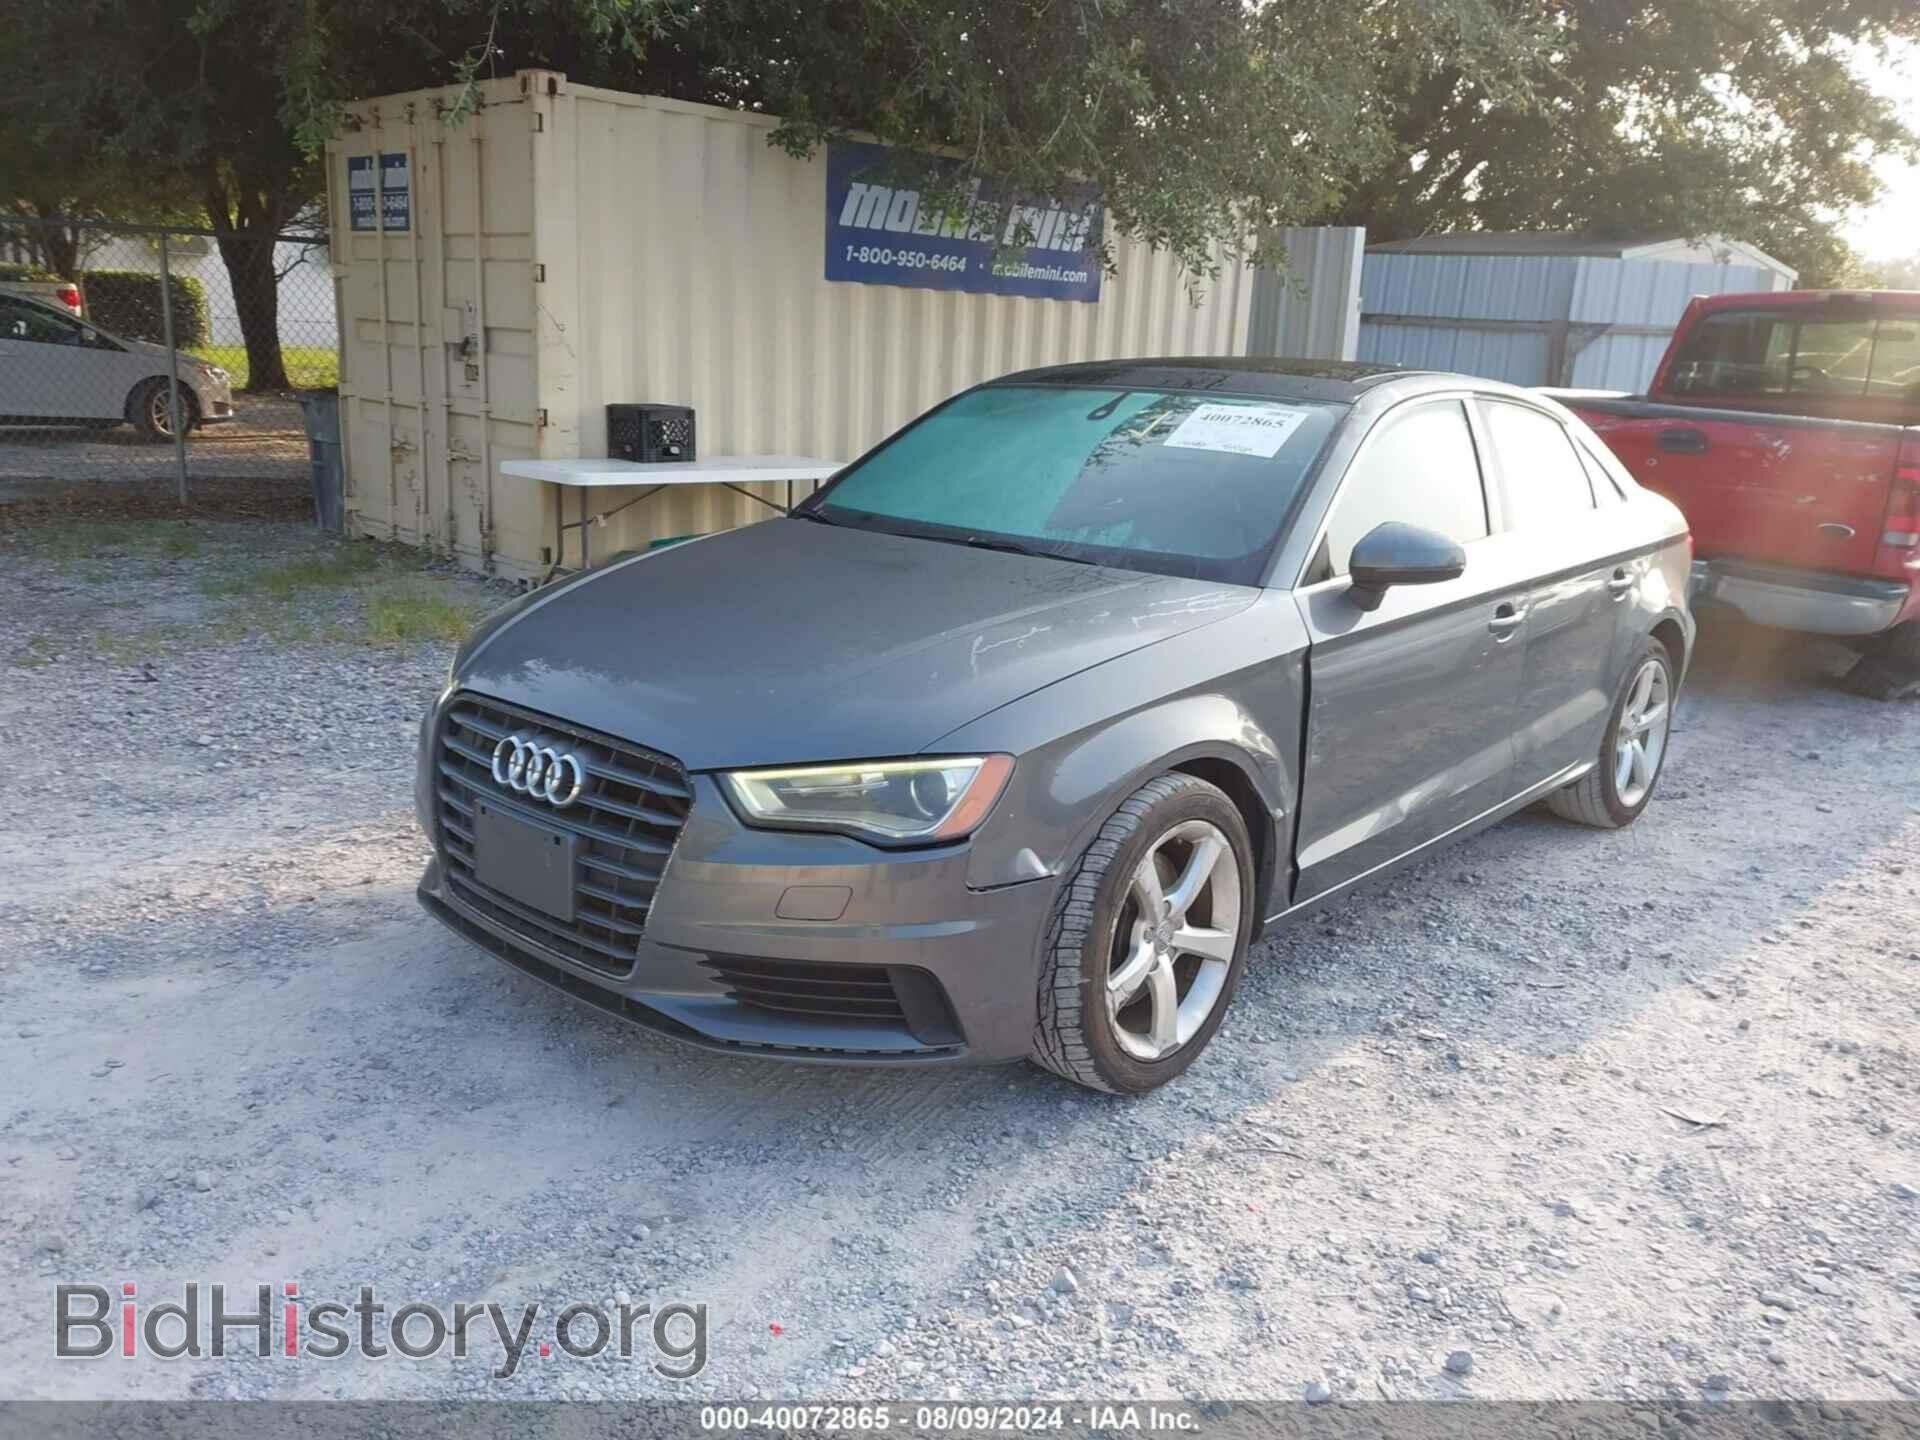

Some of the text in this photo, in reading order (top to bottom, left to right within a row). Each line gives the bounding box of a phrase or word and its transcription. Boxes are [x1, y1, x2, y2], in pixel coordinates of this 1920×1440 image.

[846, 245, 1088, 284] 1-800-950-6464 mobilemini.com
[1200, 412, 1288, 430] 40072865
